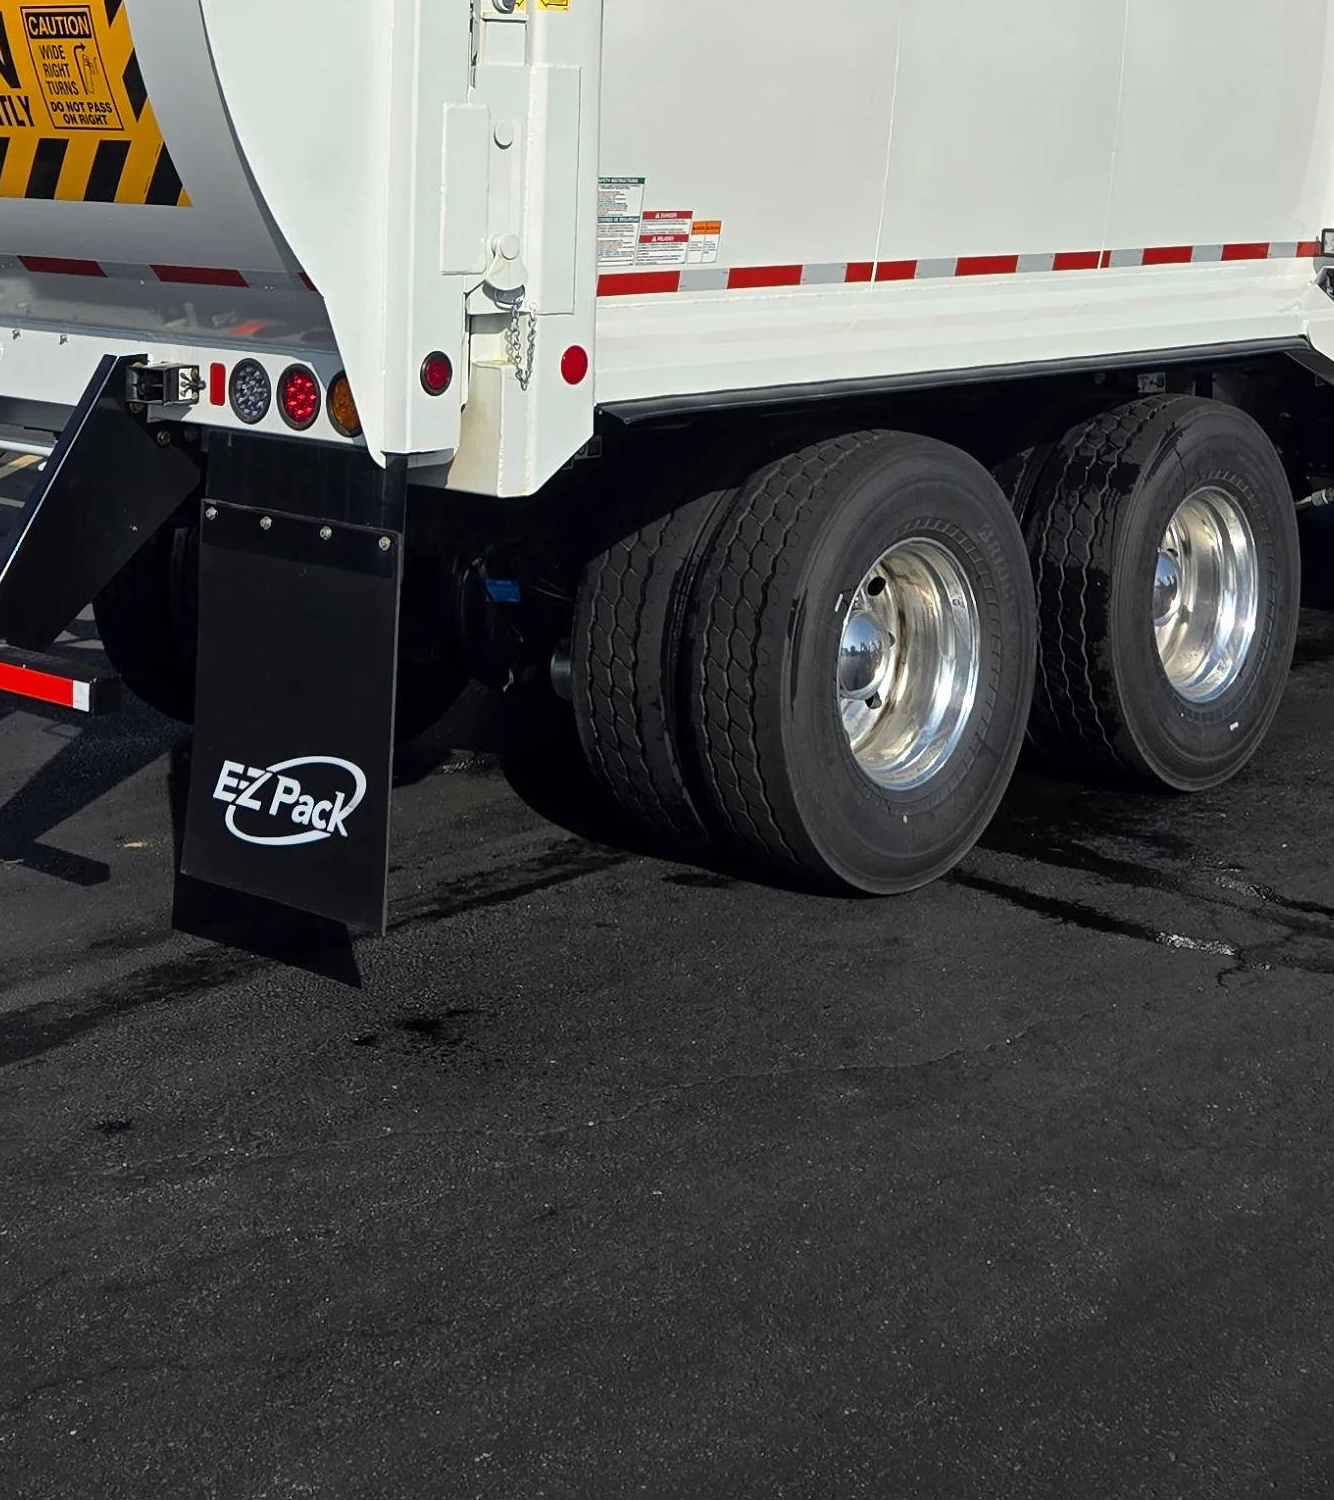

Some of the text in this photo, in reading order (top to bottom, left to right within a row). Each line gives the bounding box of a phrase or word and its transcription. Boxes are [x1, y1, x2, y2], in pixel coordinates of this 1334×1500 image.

[28, 15, 90, 36] CAUTION
[38, 45, 66, 60] WIDE
[43, 63, 71, 78] RIGHT
[46, 81, 79, 95] TURNS
[50, 101, 113, 113] DO NOT PASS
[63, 114, 108, 125] ON RIGHT
[269, 774, 352, 838] Pack
